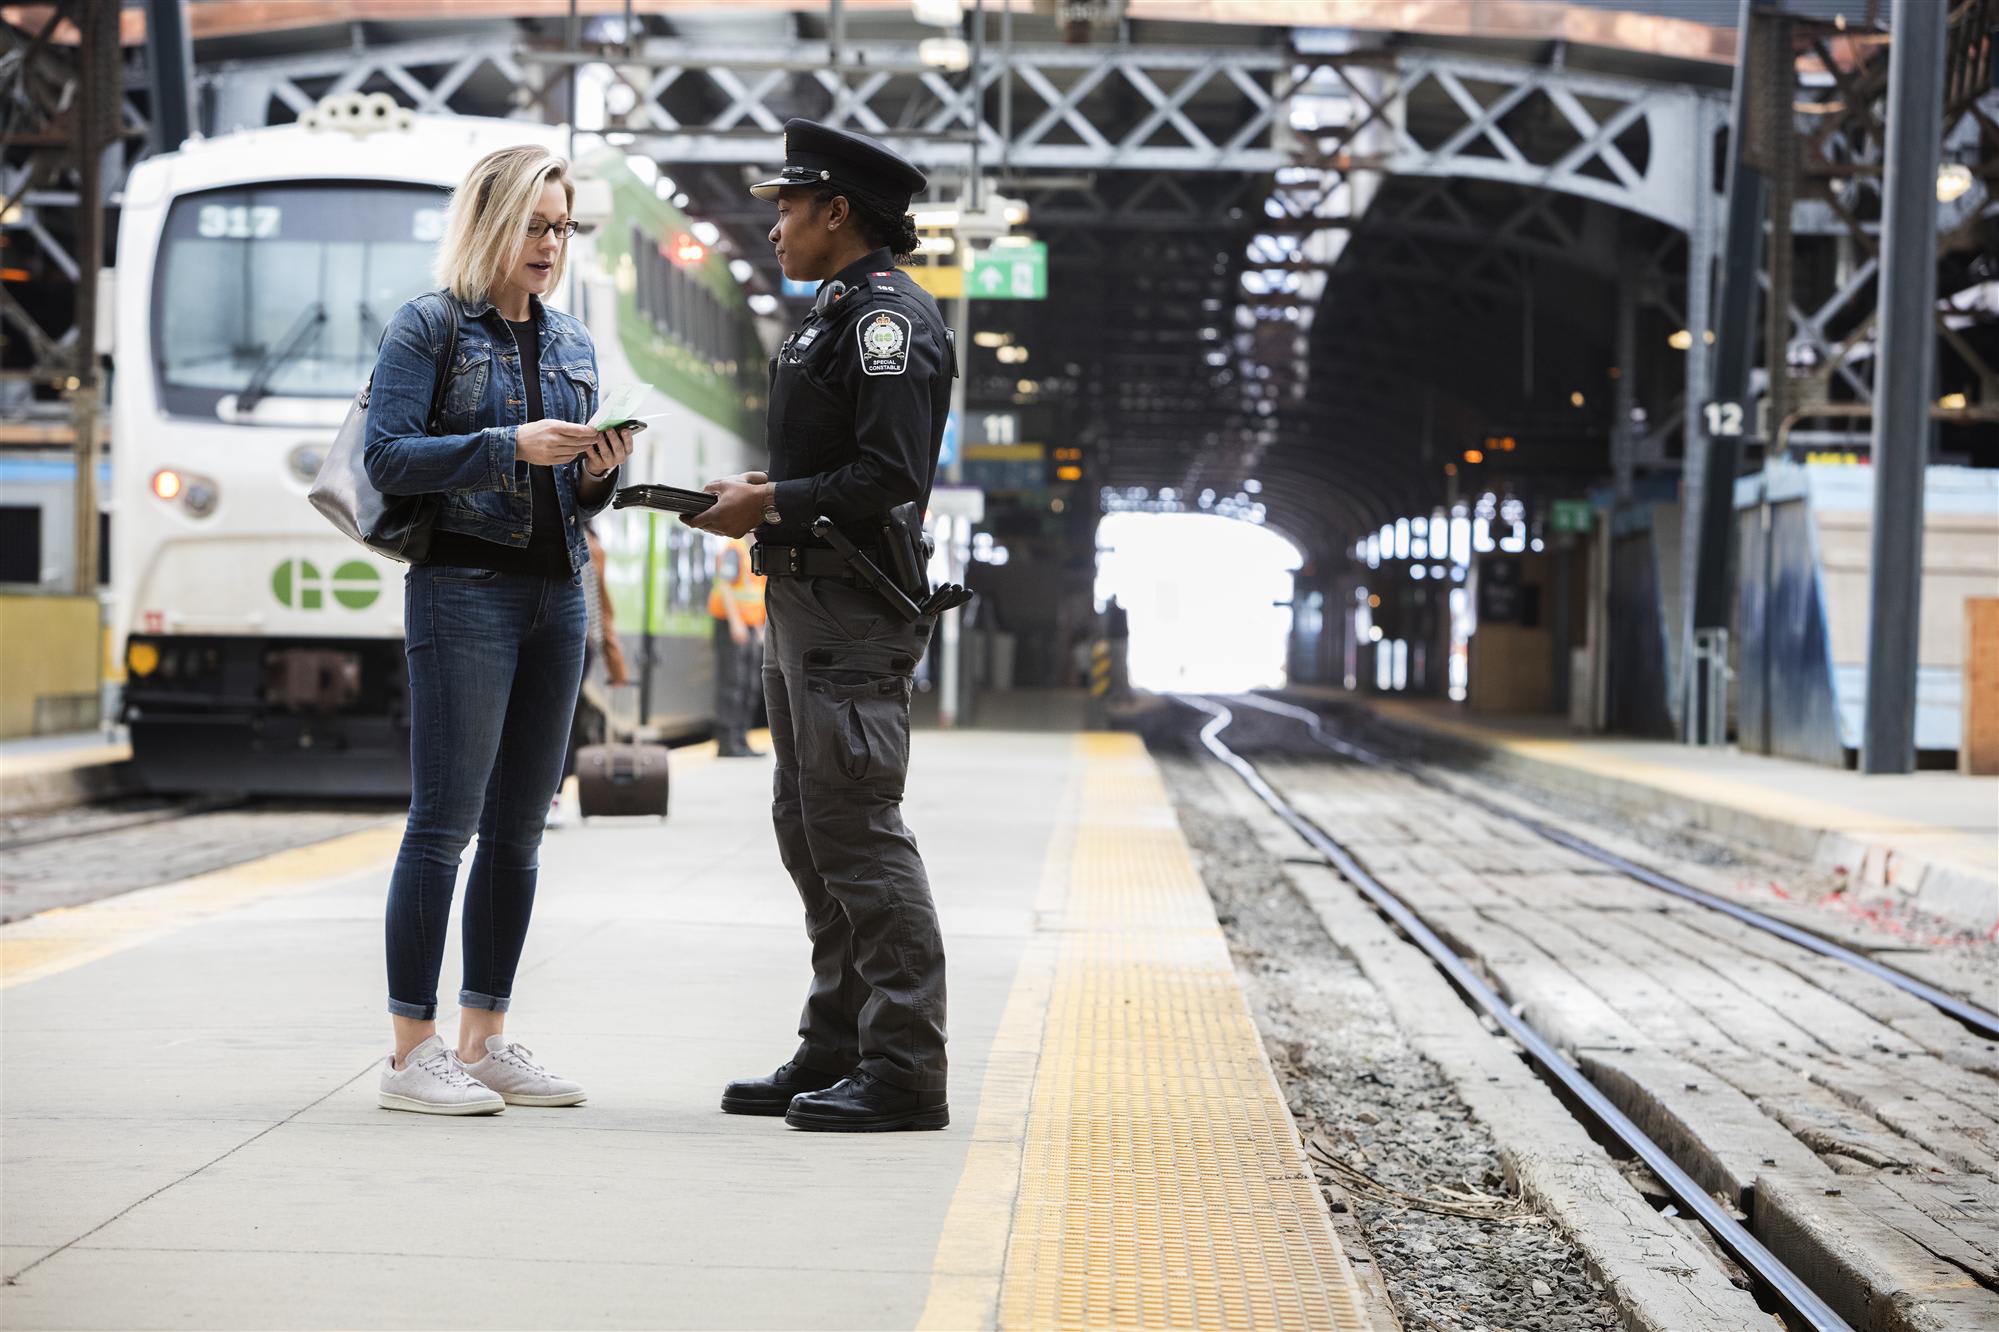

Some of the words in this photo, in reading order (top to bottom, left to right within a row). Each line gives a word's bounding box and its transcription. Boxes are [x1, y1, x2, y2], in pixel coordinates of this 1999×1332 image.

[199, 205, 281, 238] 317
[983, 414, 1014, 444] 11
[1704, 402, 1742, 436] 12
[273, 560, 381, 609] GO
